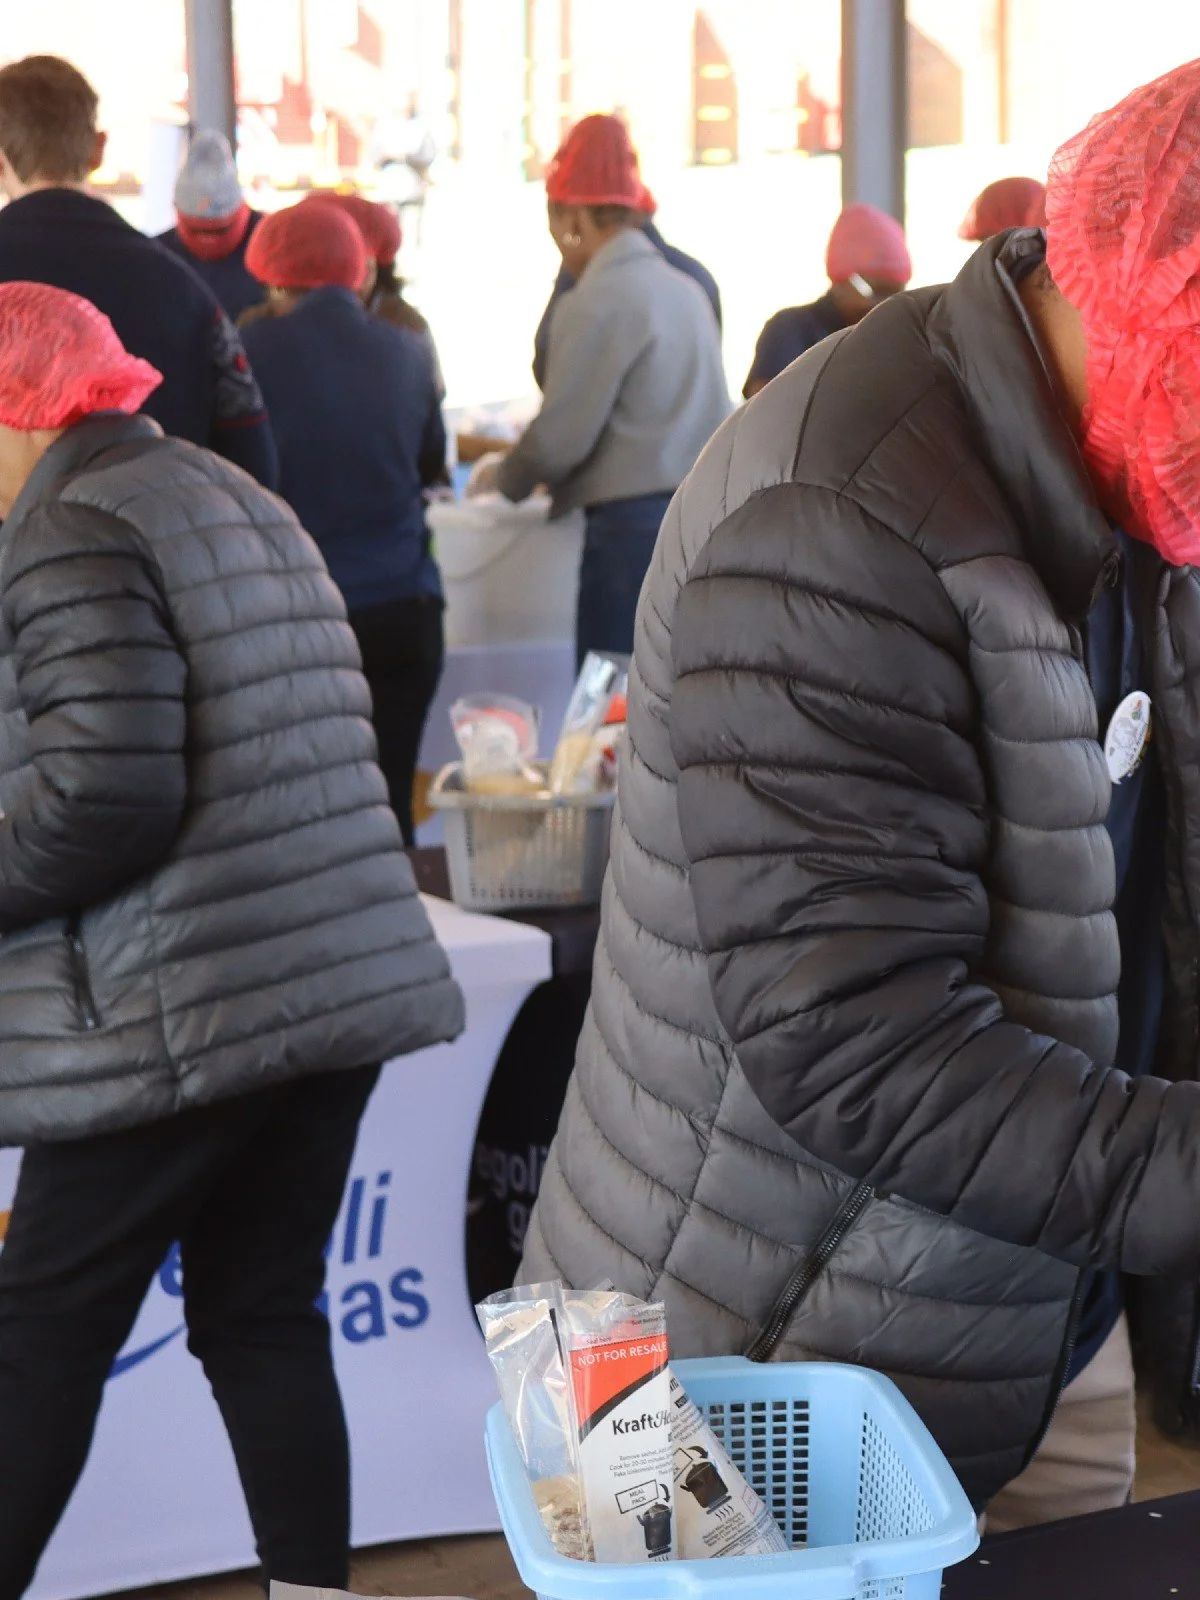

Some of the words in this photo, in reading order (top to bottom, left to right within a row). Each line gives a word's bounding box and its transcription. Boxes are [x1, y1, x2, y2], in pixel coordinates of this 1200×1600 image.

[313, 1264, 430, 1345] as
[577, 1353, 601, 1366] NOT
[603, 1348, 627, 1362] FOR
[629, 1341, 668, 1357] RESALE
[630, 1489, 645, 1497] MEAL
[632, 1496, 647, 1504] PACK
